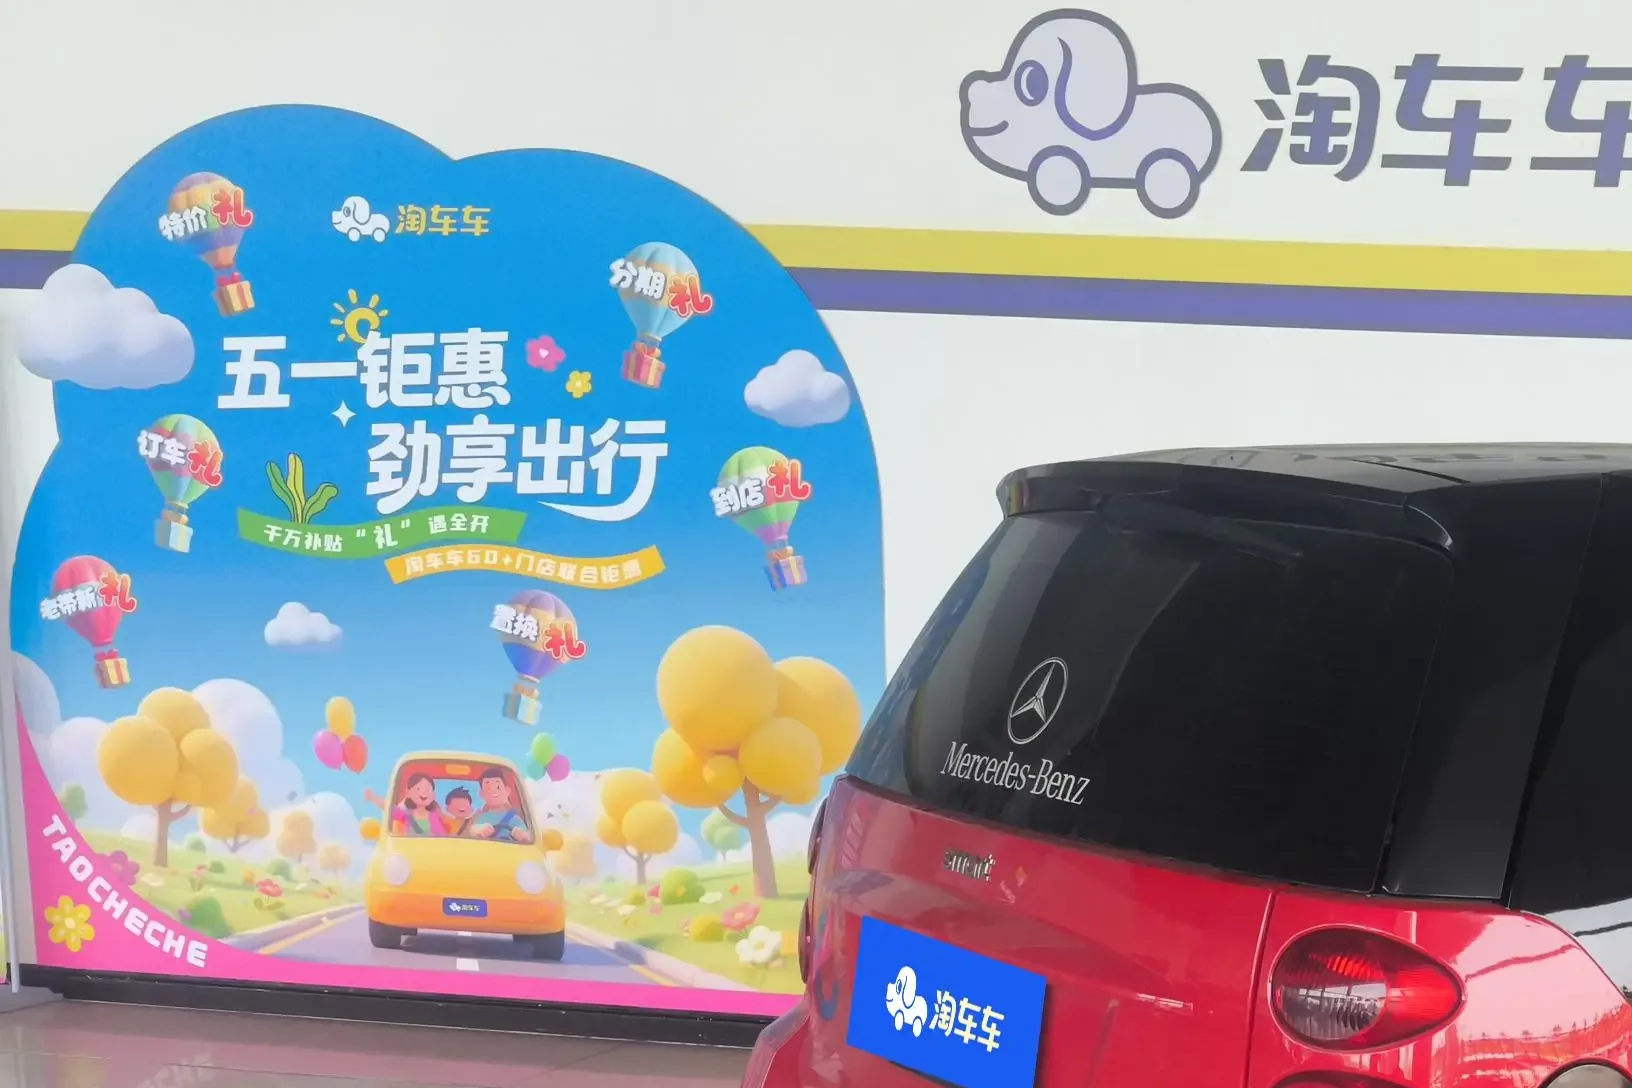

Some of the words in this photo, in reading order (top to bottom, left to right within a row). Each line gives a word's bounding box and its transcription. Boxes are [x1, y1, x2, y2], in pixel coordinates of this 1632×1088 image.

[158, 185, 255, 241] 特价礼
[394, 204, 492, 236] 淘车车
[609, 257, 714, 318] 分期礼
[217, 327, 512, 409] 五一钜惠
[137, 430, 224, 487] 订车礼
[366, 413, 669, 522] 劲享出行
[709, 457, 813, 517] 到店礼
[489, 603, 587, 660] 置换礼
[939, 740, 1092, 806] Mercedes-Benz
[42, 813, 209, 968] TAOCHECHE
